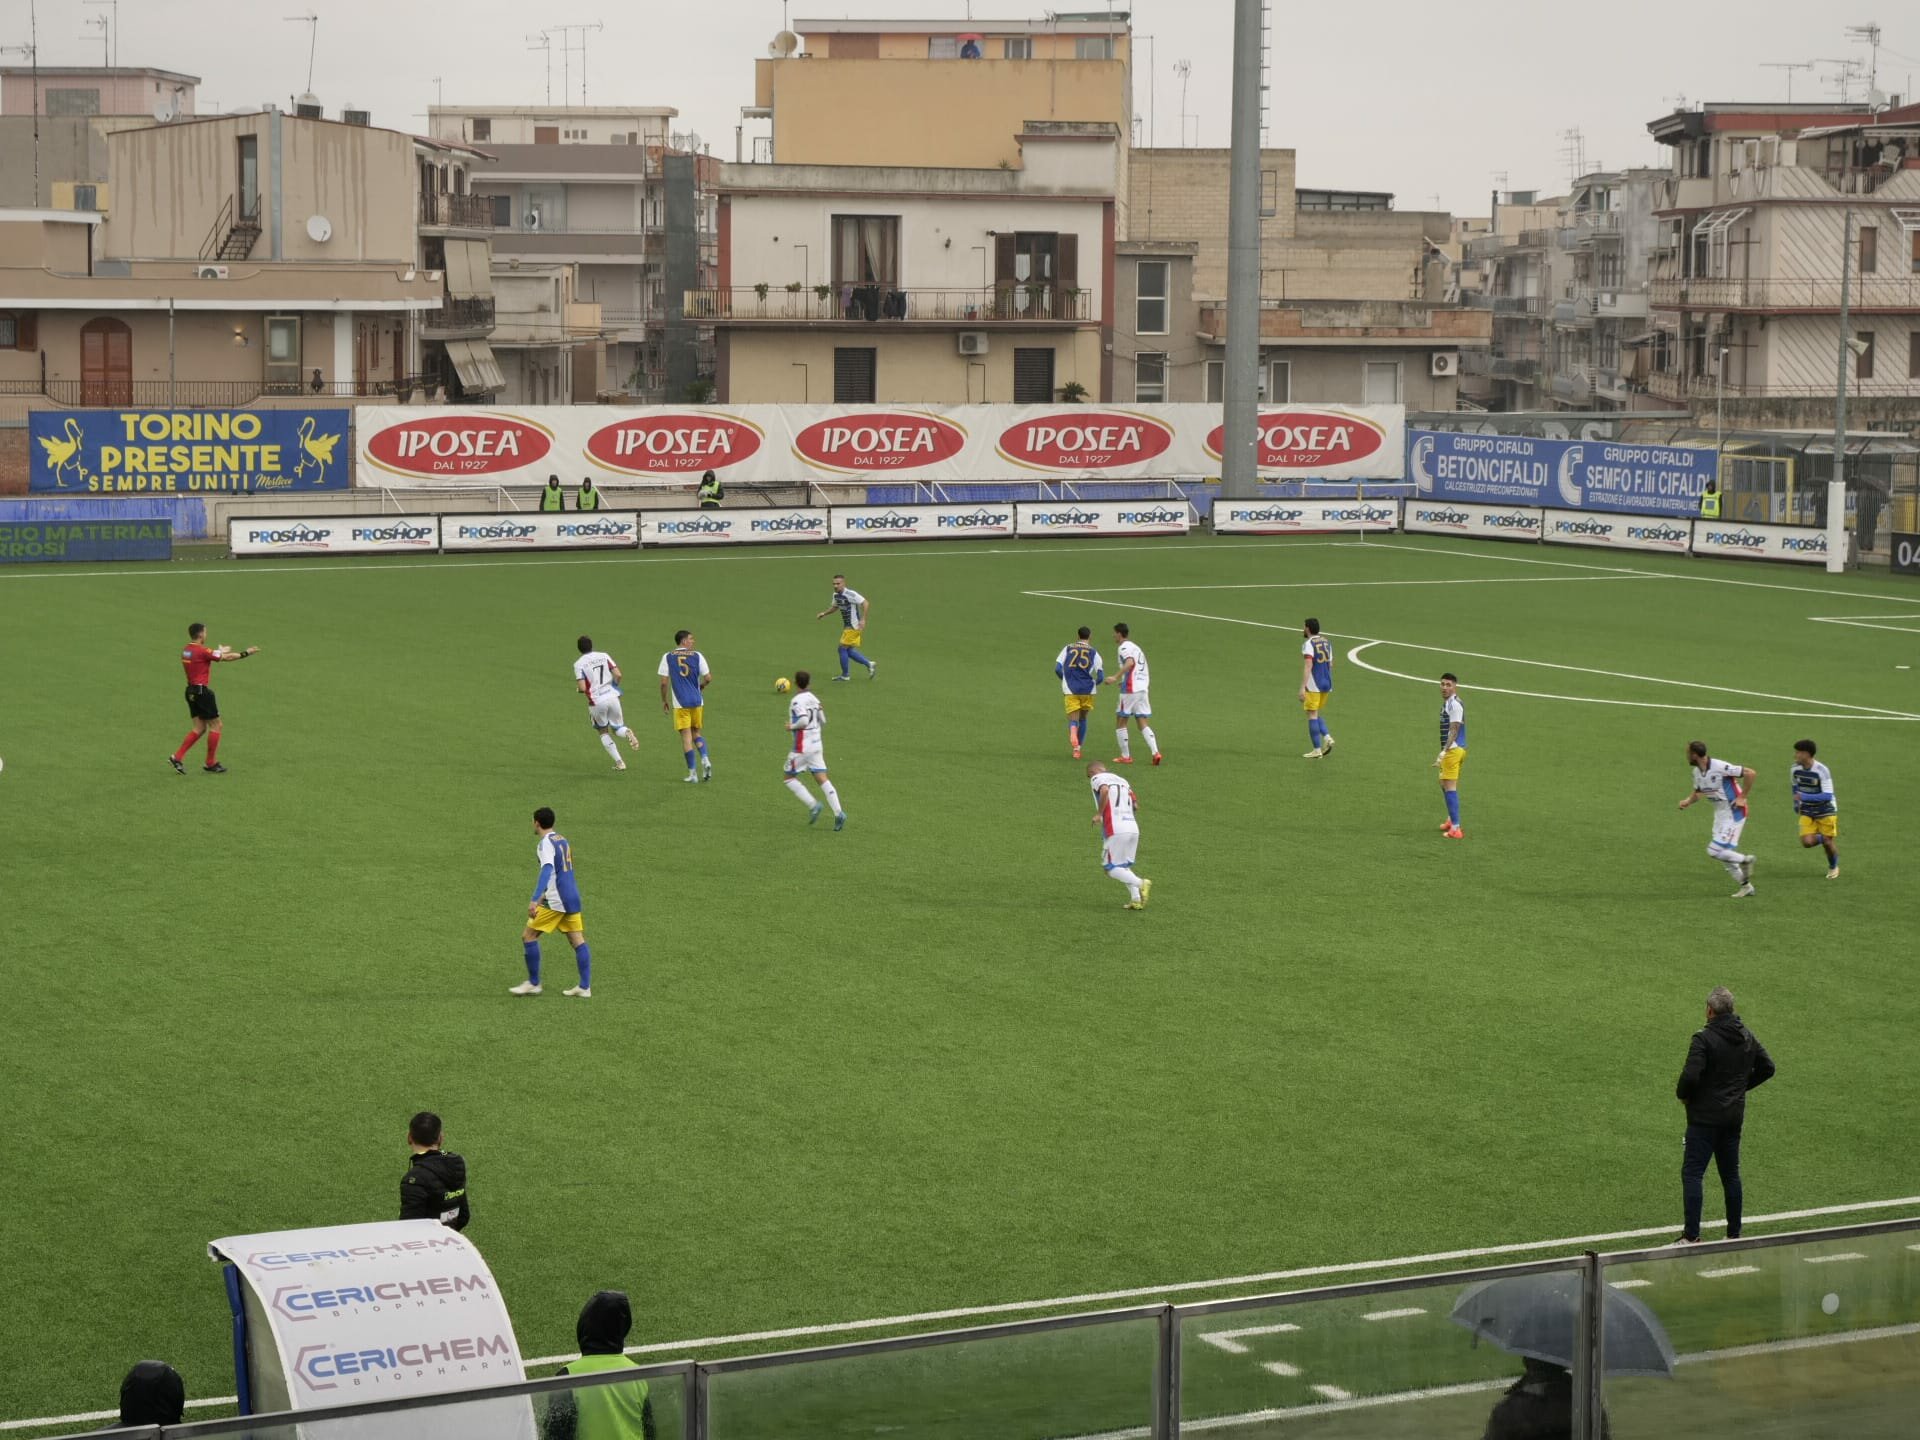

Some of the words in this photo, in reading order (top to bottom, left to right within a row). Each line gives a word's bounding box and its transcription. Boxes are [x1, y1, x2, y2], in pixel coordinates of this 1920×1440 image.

[120, 413, 261, 441] TORINO
[398, 430, 519, 457] IPOSEA
[615, 429, 731, 455] IPOSEA
[822, 427, 934, 452] IPOSEA
[1026, 426, 1141, 452] IPOSEA
[1453, 437, 1495, 453] GRUPPO
[1496, 441, 1534, 456] CIFALDI
[101, 445, 281, 473] PRESENTE
[649, 459, 671, 468] DAL
[675, 458, 702, 468] 1927
[854, 456, 875, 466] DAL
[879, 456, 905, 465] 1927
[1059, 456, 1079, 465] DAL
[1084, 455, 1111, 464] 1927
[1267, 454, 1290, 463] DAL
[1293, 454, 1321, 464] 1927
[1603, 447, 1649, 464] GRUPPO
[1651, 450, 1693, 467] CIFALDI
[433, 461, 454, 471] DAL
[460, 460, 488, 470] 1927
[1437, 455, 1548, 487] BETONCIFALDI
[88, 473, 176, 492] SEMPRE
[188, 473, 248, 490] UNITI
[1586, 466, 1631, 492] SEMFO
[1444, 480, 1486, 495] CALCESTRUZZI
[846, 516, 919, 529] PROSHOP
[937, 514, 1008, 528] PROSHOP
[1031, 512, 1100, 525] PROSHOP
[1118, 511, 1184, 524] PROSHOP
[1230, 510, 1303, 521] PROSHOP
[1322, 509, 1393, 521] PROSHOP
[1416, 510, 1469, 524] PROSHOP
[1483, 514, 1538, 529] PROSHOP
[459, 525, 536, 538] PROSHOP
[557, 523, 632, 537] PROSHOP
[658, 521, 731, 533] PROSHOP
[751, 518, 823, 532] PROSHOP
[1556, 520, 1612, 535] PROSHOP
[249, 529, 331, 543] PROSHOP
[352, 527, 432, 541] PROSHOP
[1627, 526, 1687, 541] PROSHOP
[1706, 532, 1766, 547] PROSHOP
[1782, 537, 1827, 551] PROSH
[677, 656, 690, 677] 5
[1068, 649, 1091, 669] 25
[592, 664, 604, 685] 7
[259, 1237, 461, 1266] CERICHEM
[285, 1274, 487, 1312] CERICHEM
[307, 1334, 510, 1379] CERICHEM
